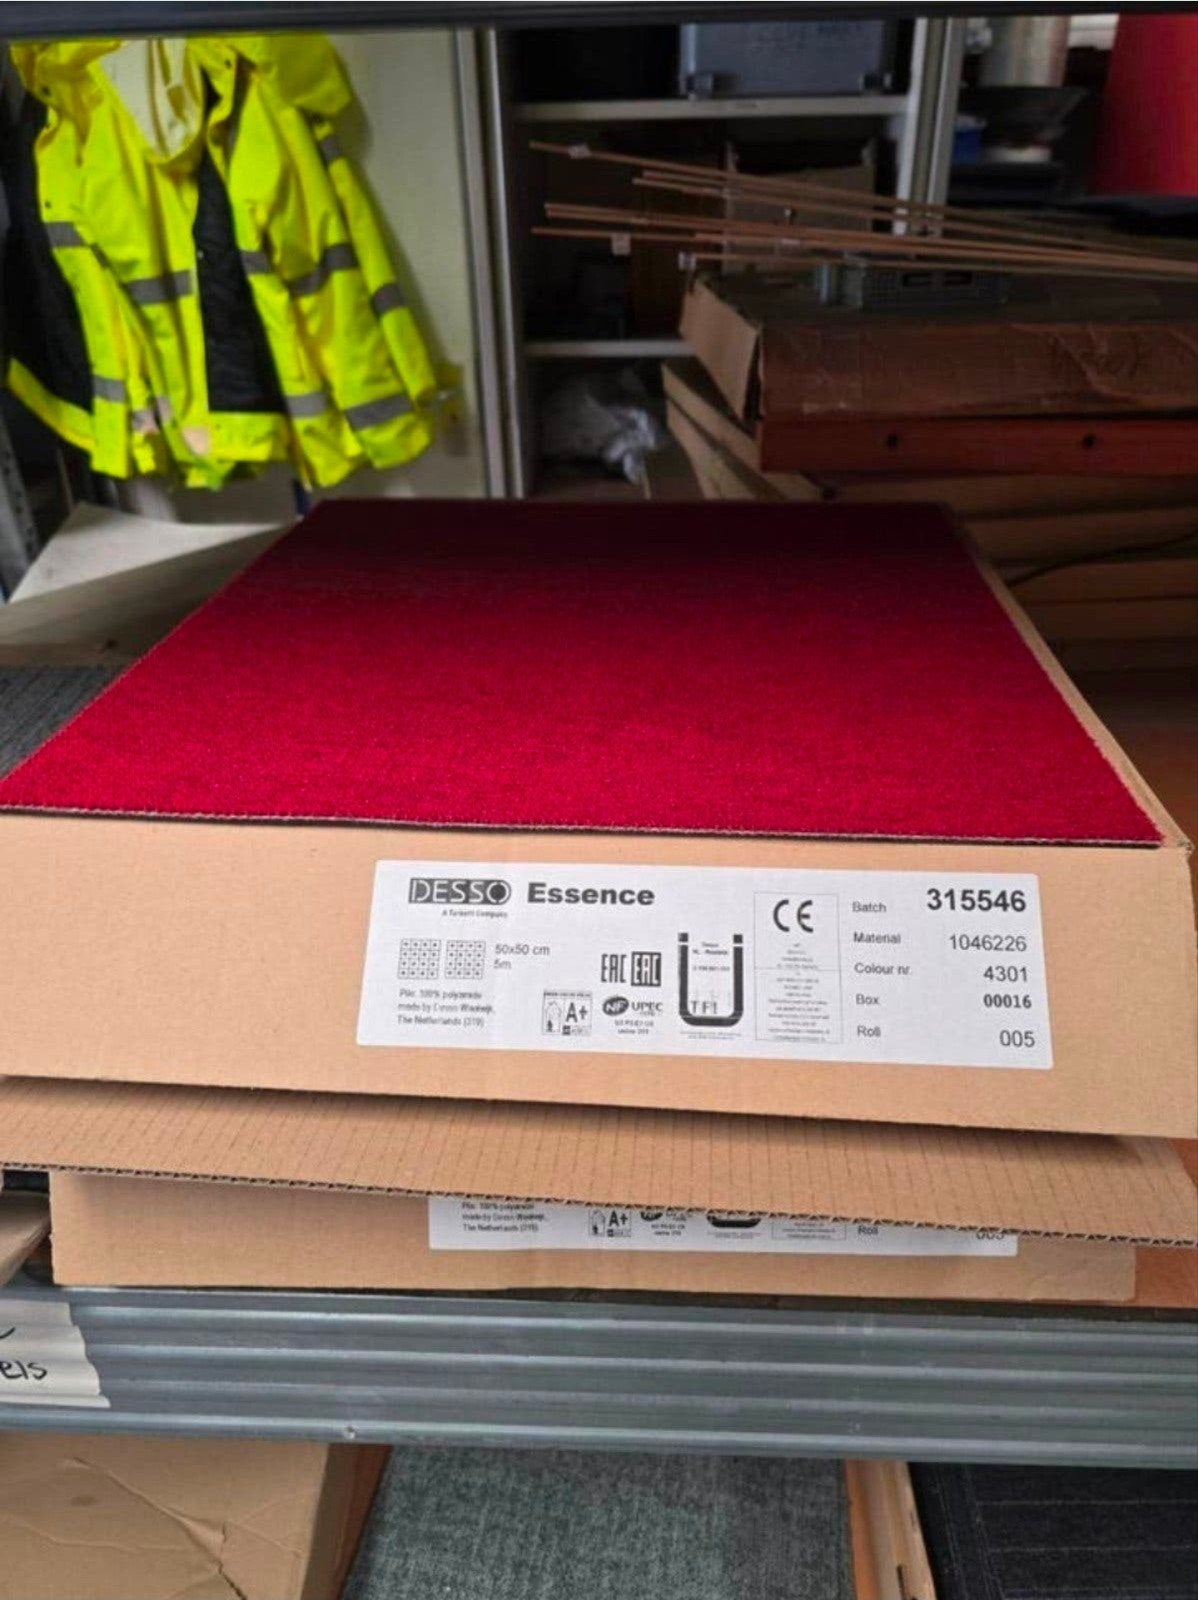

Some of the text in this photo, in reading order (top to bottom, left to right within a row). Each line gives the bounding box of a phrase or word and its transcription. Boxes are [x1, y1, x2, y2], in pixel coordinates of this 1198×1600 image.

[409, 878, 511, 905] DESSO
[527, 882, 655, 905] Essence
[926, 888, 1027, 912] 315546
[773, 898, 814, 933] CE
[852, 901, 887, 913] Batch
[853, 931, 901, 944] Material
[950, 934, 1028, 951] 1046226
[494, 943, 550, 955] 50x50 cm
[600, 953, 627, 983] EAC
[631, 951, 661, 987] EAC
[854, 962, 894, 975] Colour
[983, 966, 1028, 982] 4301
[855, 994, 879, 1005] Box
[983, 993, 1032, 1008] 00016
[566, 1002, 588, 1023] A+
[857, 1025, 881, 1038] Roll
[999, 1030, 1036, 1047] 005
[609, 1210, 628, 1227] A+
